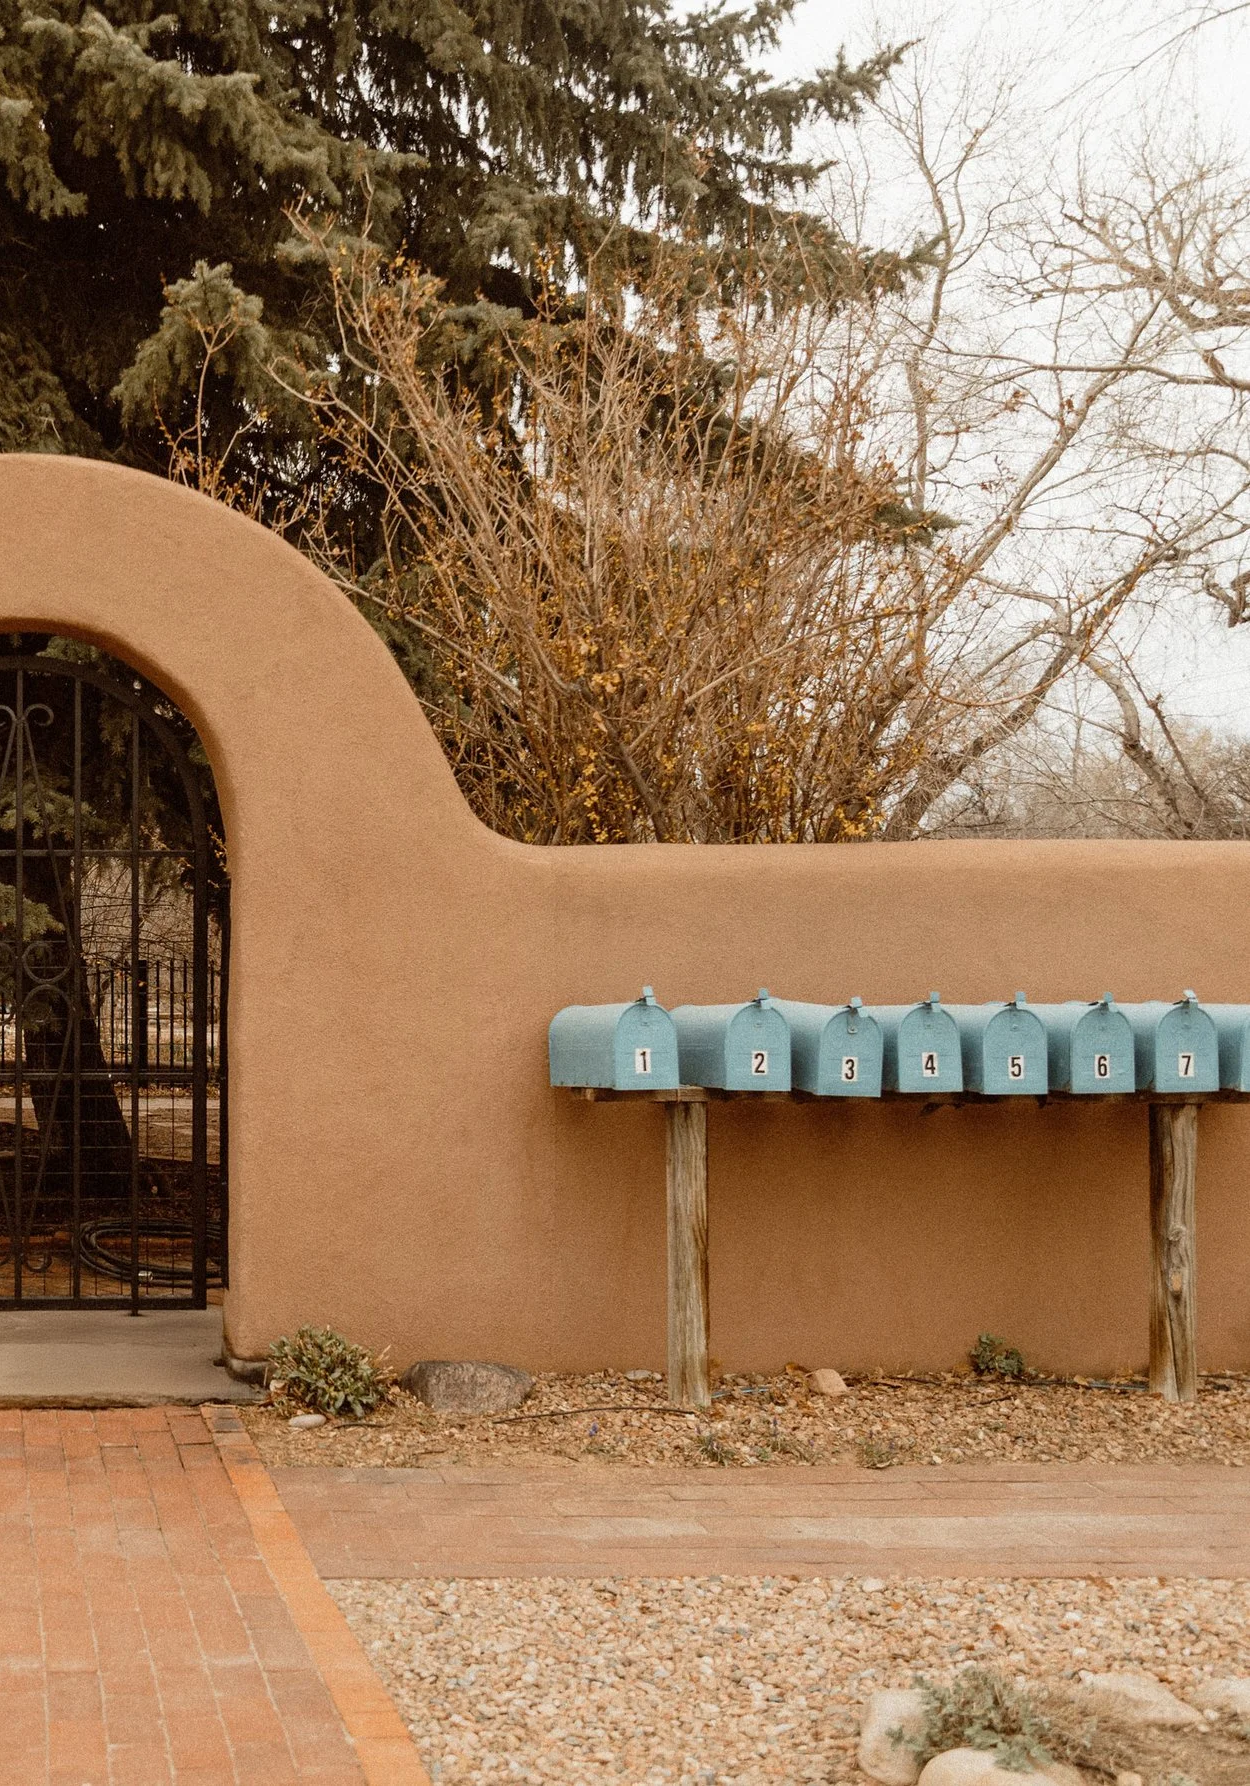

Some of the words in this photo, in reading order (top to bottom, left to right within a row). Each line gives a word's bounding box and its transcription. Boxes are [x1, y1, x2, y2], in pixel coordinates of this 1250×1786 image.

[640, 1051, 648, 1072] 1
[754, 1053, 765, 1074] 2
[845, 1059, 856, 1080] 3
[924, 1054, 936, 1075] 4
[1011, 1057, 1022, 1077] 5
[1097, 1056, 1108, 1077] 6
[1182, 1055, 1191, 1076] 7
